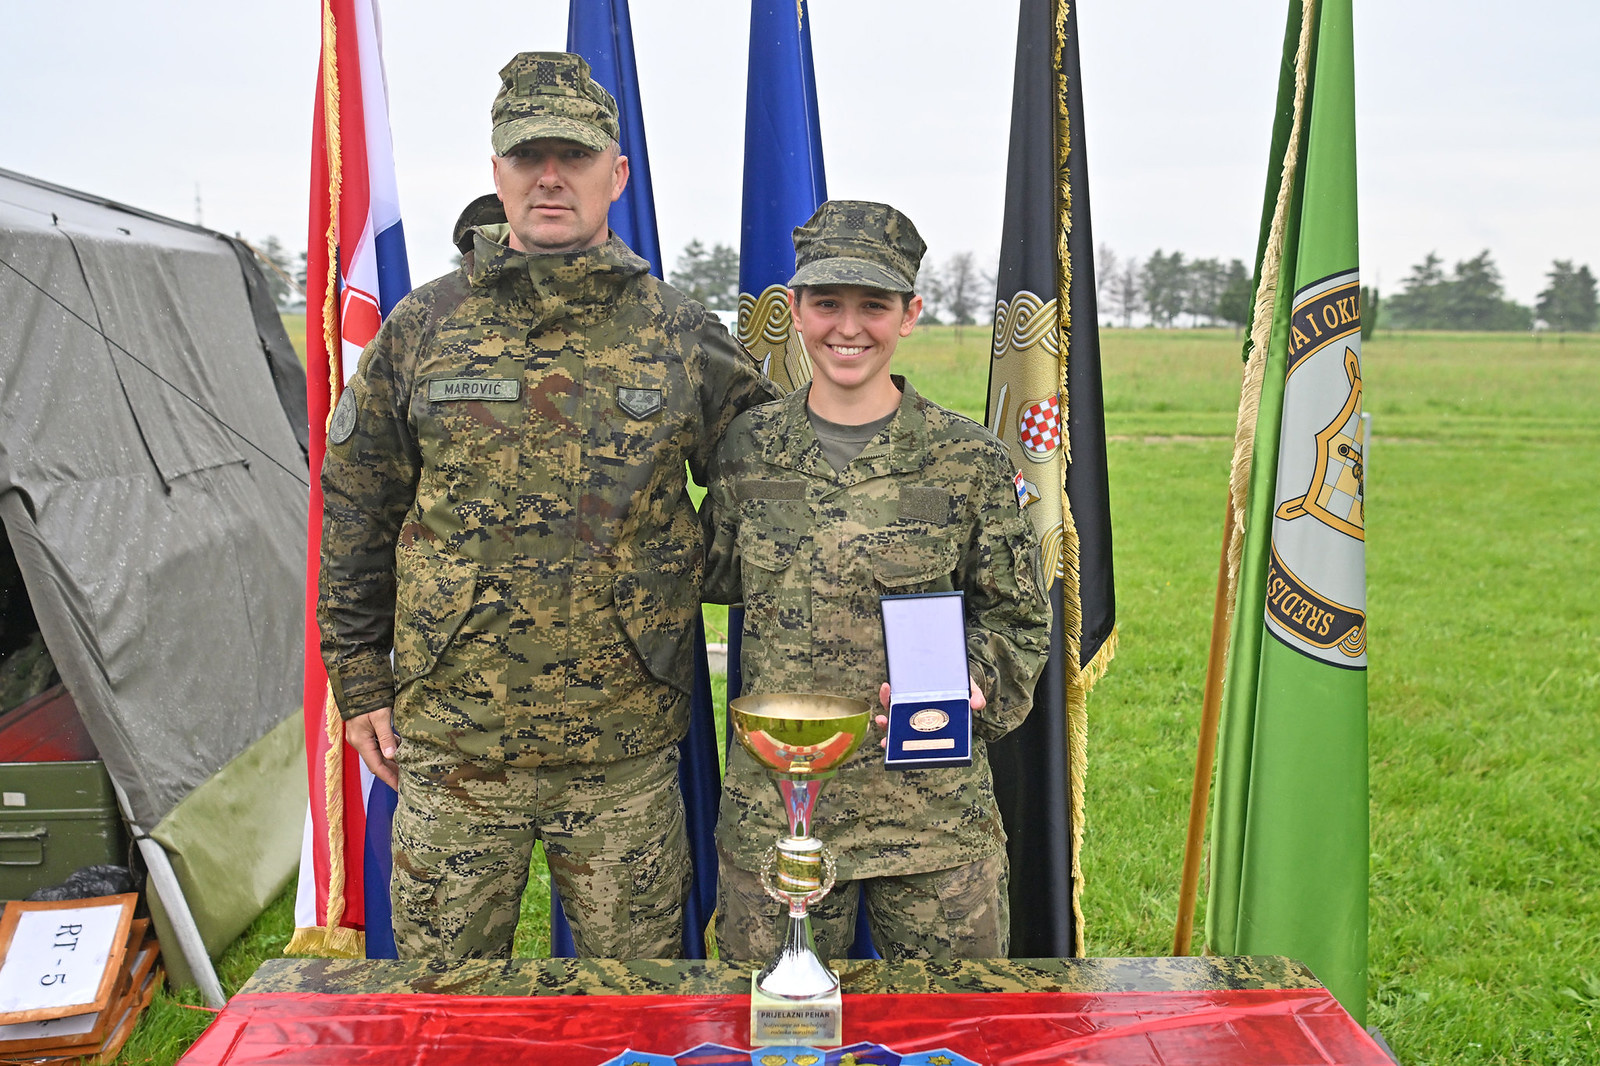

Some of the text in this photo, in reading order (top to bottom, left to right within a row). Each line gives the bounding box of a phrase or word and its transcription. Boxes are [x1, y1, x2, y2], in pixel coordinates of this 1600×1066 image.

[1306, 312, 1323, 337] I
[1323, 296, 1360, 329] OKL
[444, 381, 502, 395] MAROVIĆ
[54, 923, 83, 951] RT
[40, 973, 67, 986] 5
[761, 1011, 804, 1019] PRIJELAZNI
